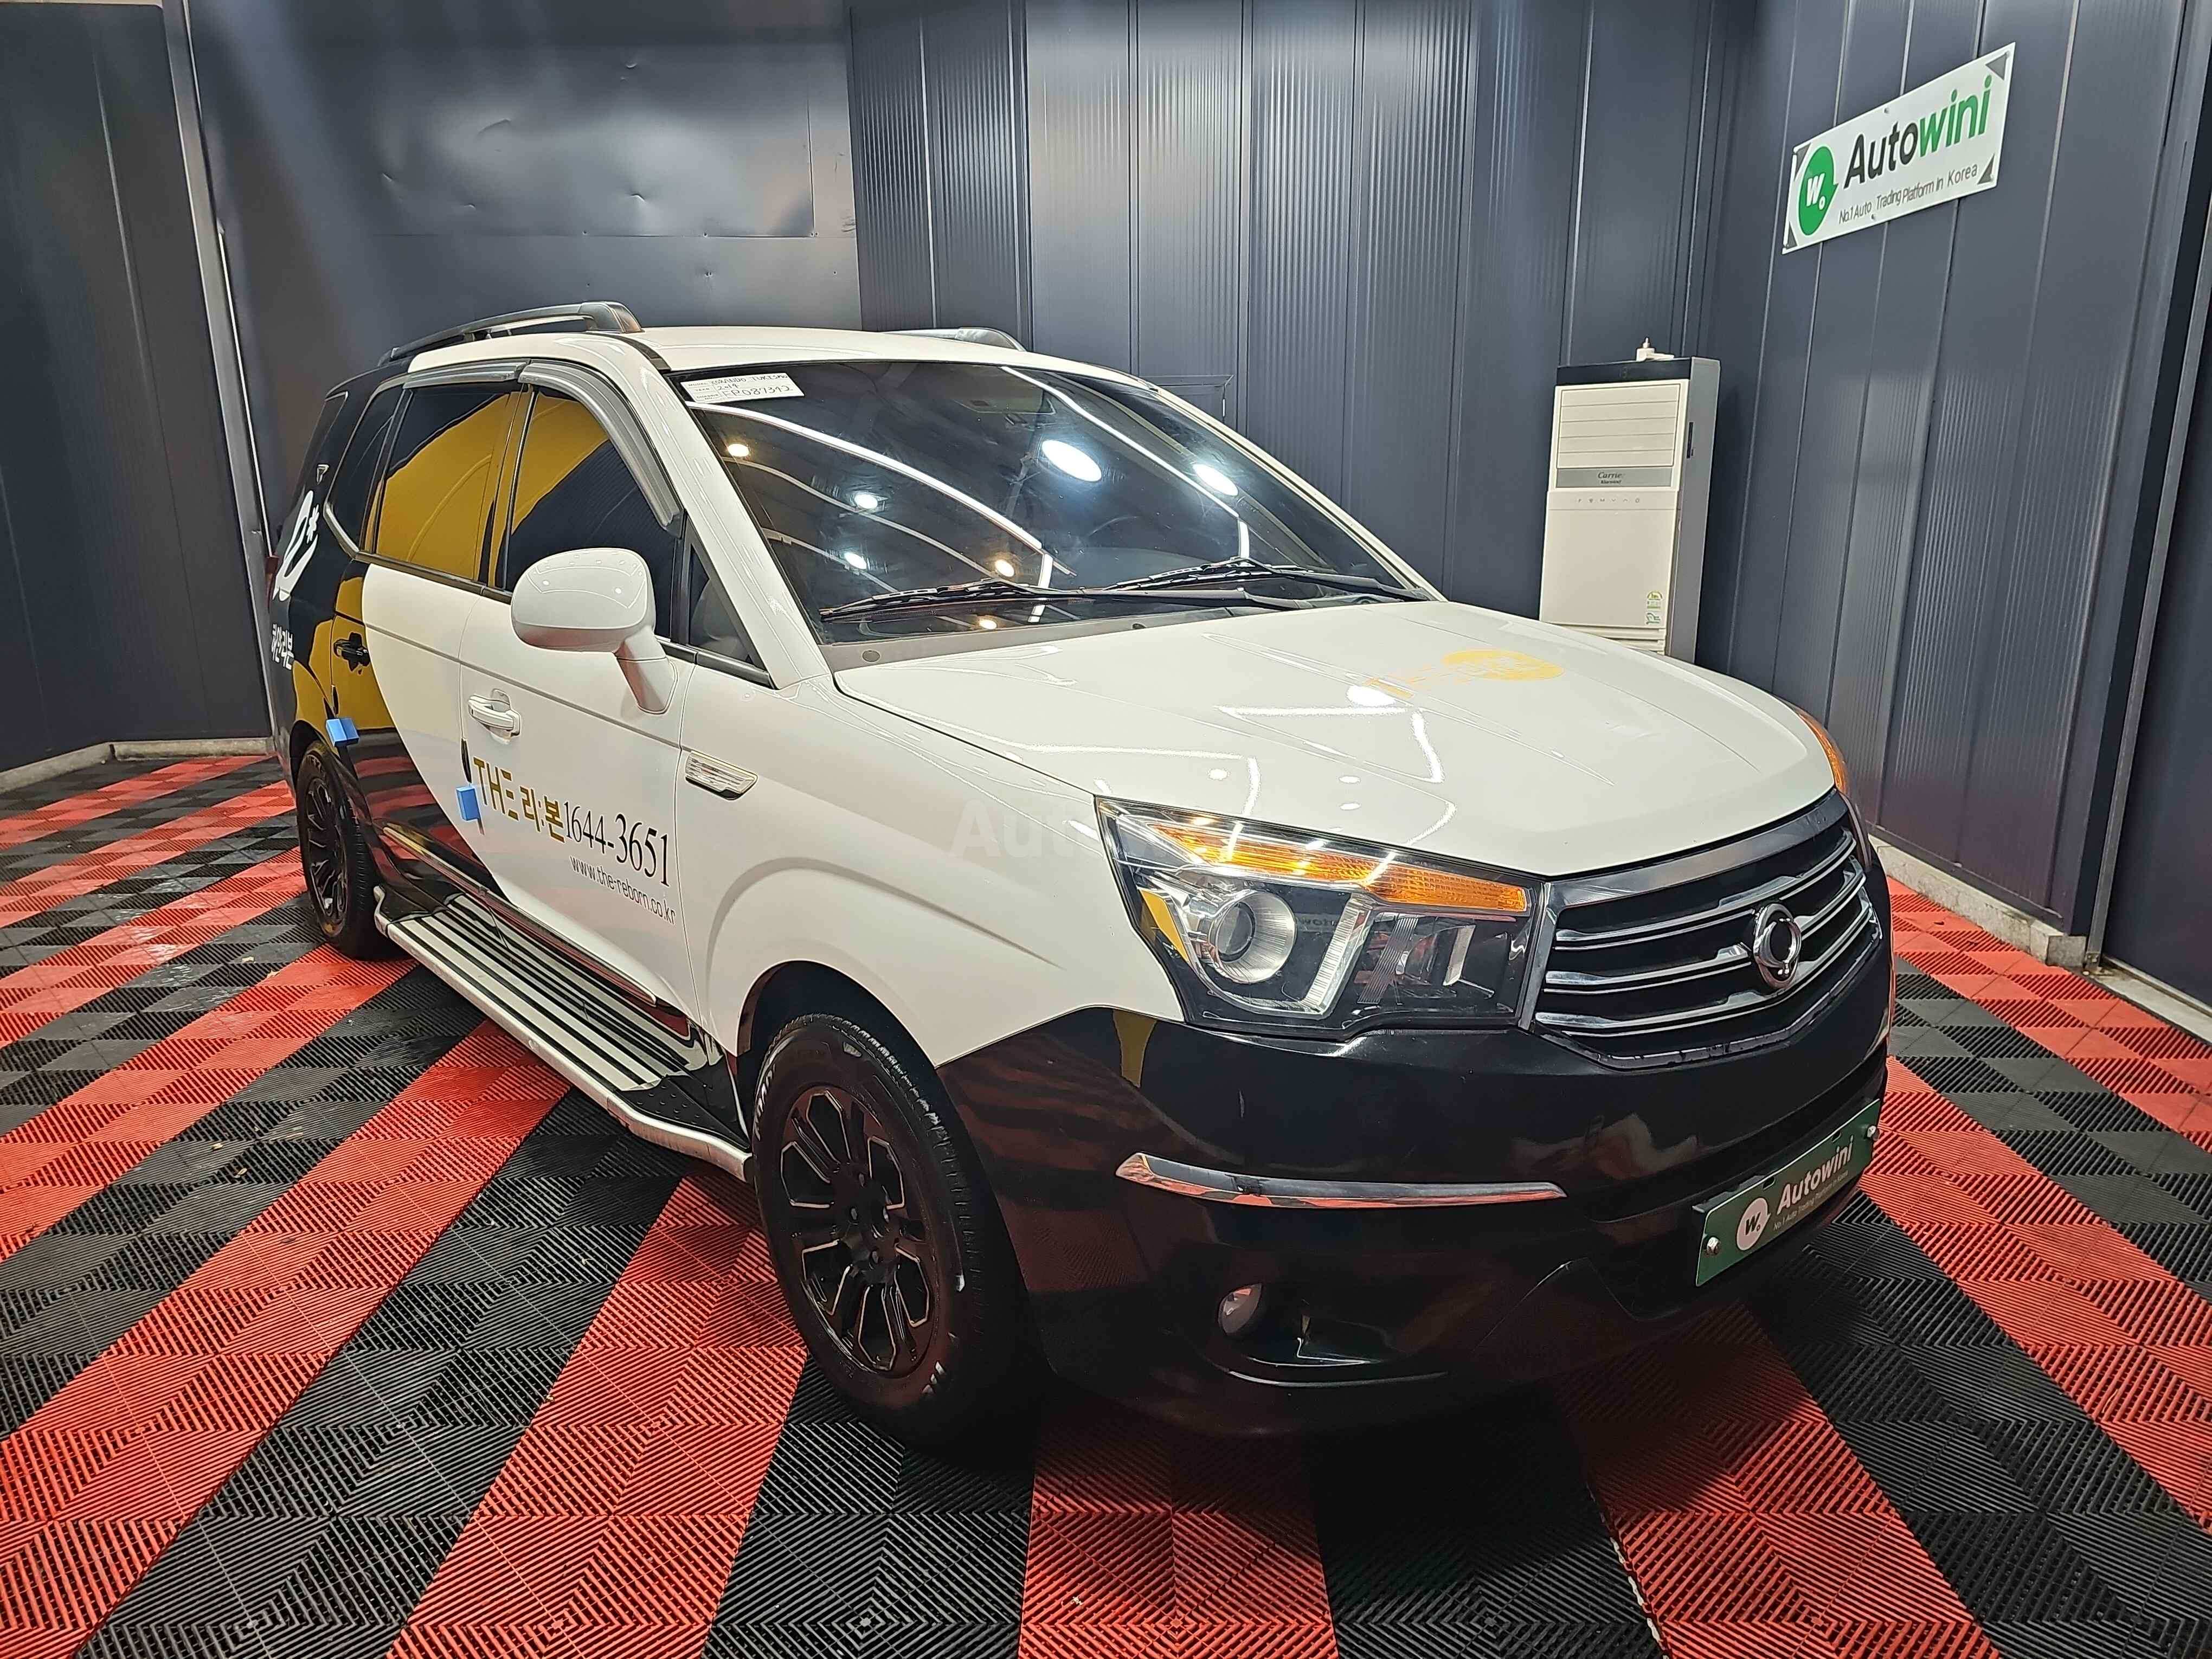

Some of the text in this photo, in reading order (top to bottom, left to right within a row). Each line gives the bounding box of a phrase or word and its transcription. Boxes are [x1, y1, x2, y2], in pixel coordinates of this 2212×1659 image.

[1843, 74, 1992, 189] Autowini
[1854, 202, 1873, 218] Auto
[1876, 190, 1902, 210] Trading
[1902, 182, 1934, 203] Platform
[1947, 164, 1978, 188] Korea
[564, 801, 670, 887] 1644-3651
[570, 856, 676, 925] www.the-reborn.co.kr
[1777, 1135, 1853, 1215] Autowini
